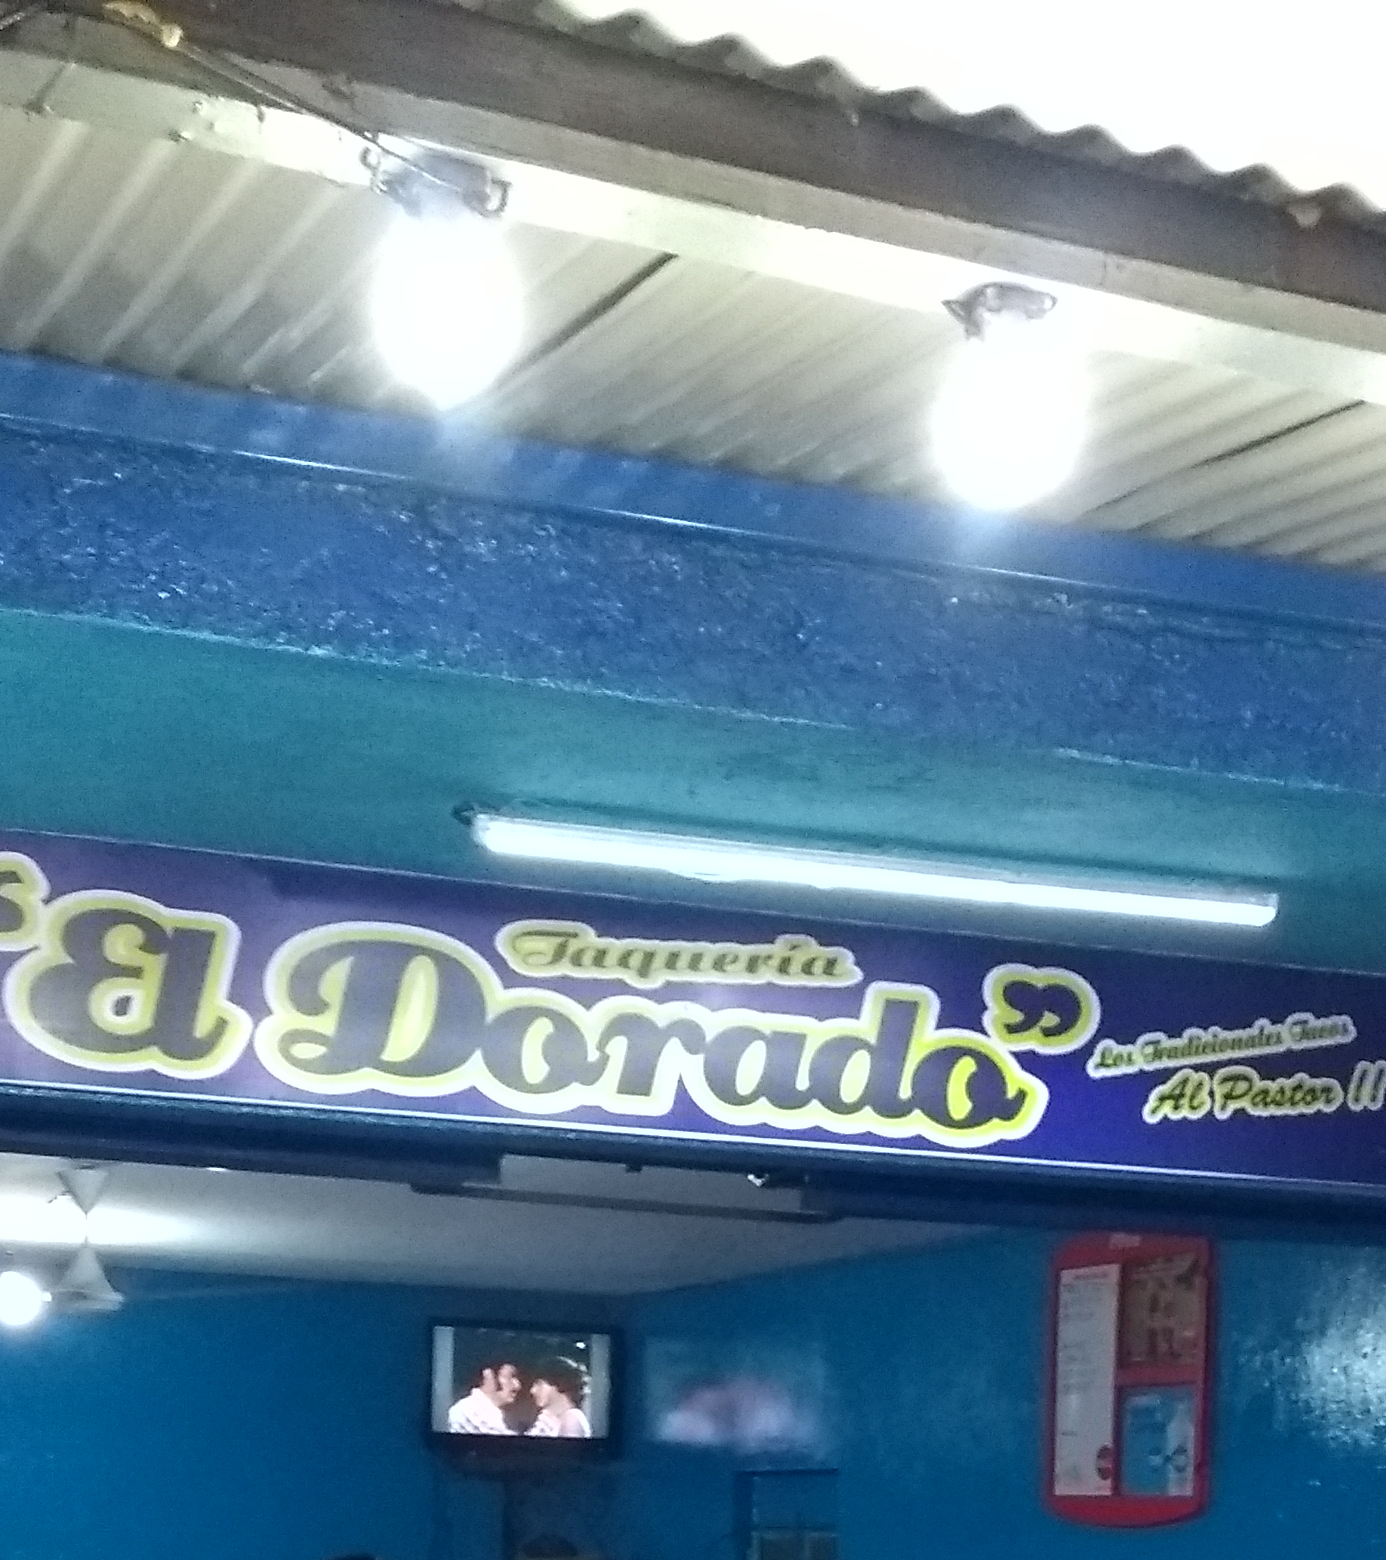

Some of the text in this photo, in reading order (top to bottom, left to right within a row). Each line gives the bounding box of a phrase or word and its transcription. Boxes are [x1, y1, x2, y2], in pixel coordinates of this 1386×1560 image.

[502, 922, 854, 986] Taquería
[1091, 1041, 1136, 1074] Los
[1138, 1022, 1282, 1067] Tradicionales
[1145, 1070, 1210, 1121] Al
[1214, 1068, 1341, 1119] Pastor
